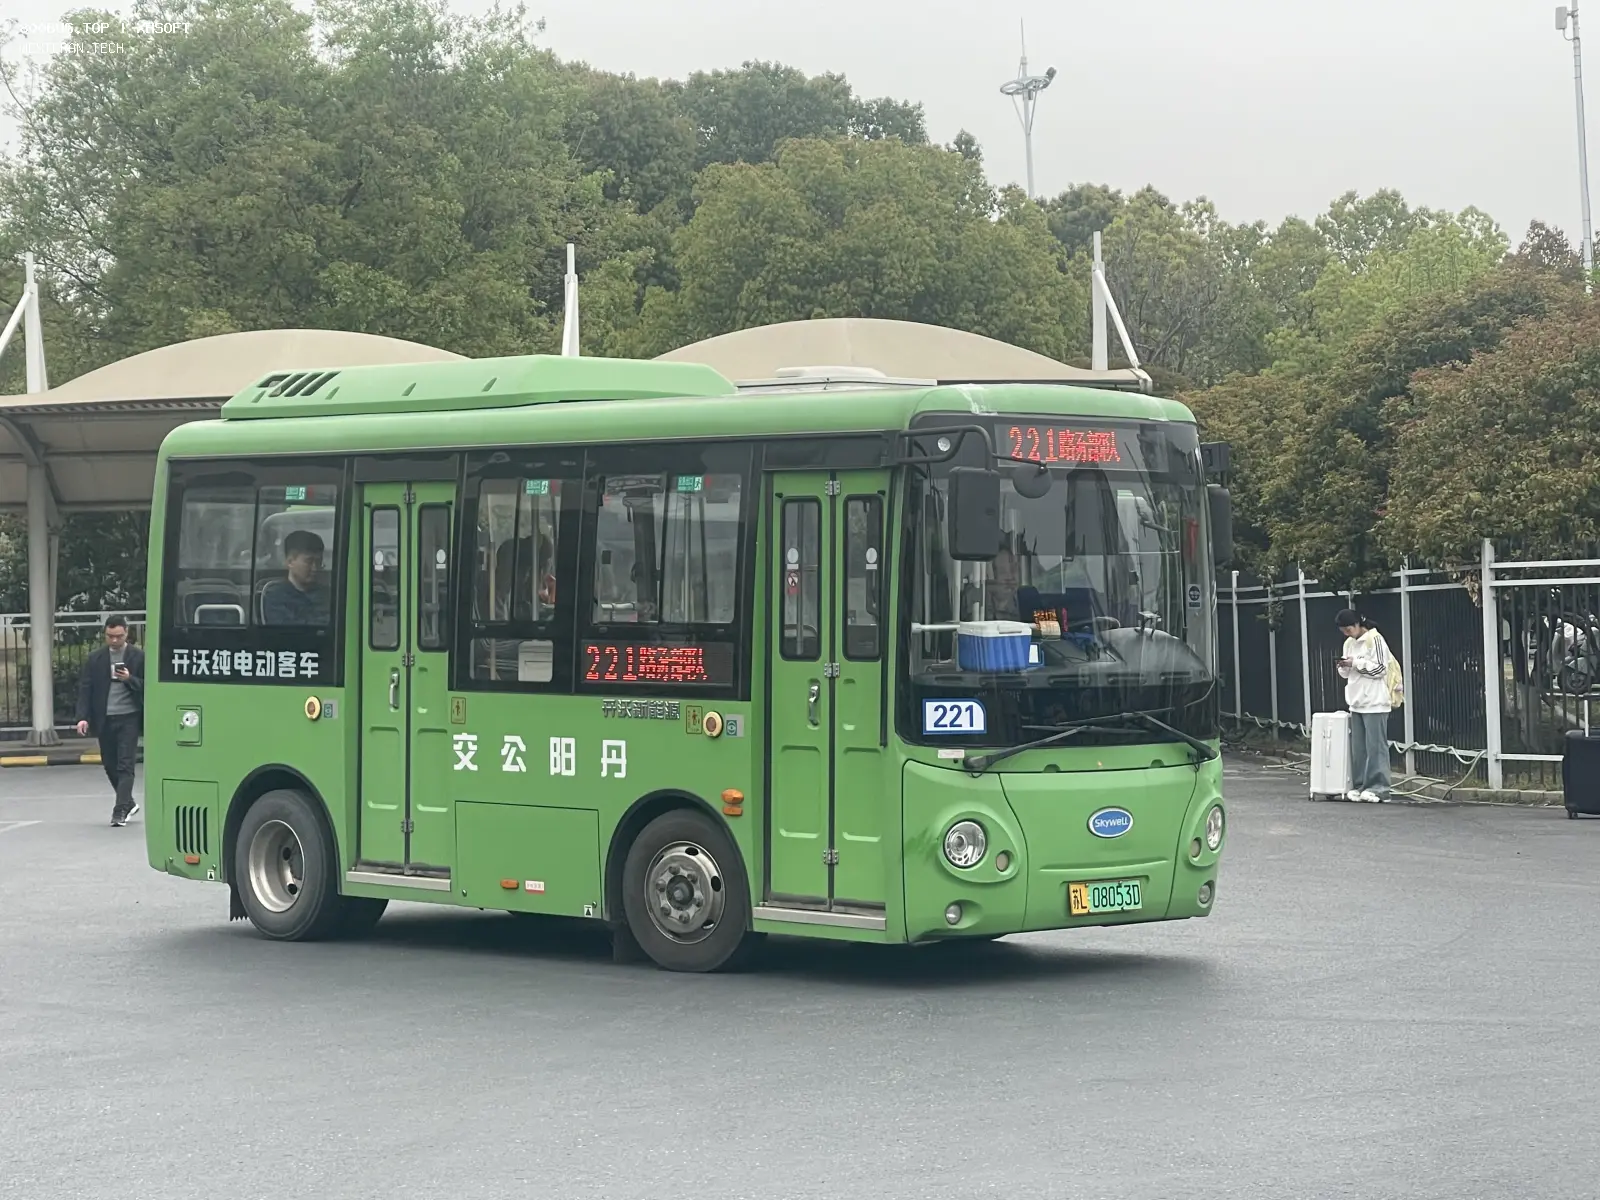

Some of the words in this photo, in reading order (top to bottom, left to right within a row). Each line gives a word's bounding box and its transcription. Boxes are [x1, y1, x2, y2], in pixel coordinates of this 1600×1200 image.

[172, 649, 319, 678] 开沃纯电动客车
[602, 699, 680, 720] 开沃新能源
[933, 704, 974, 728] 221
